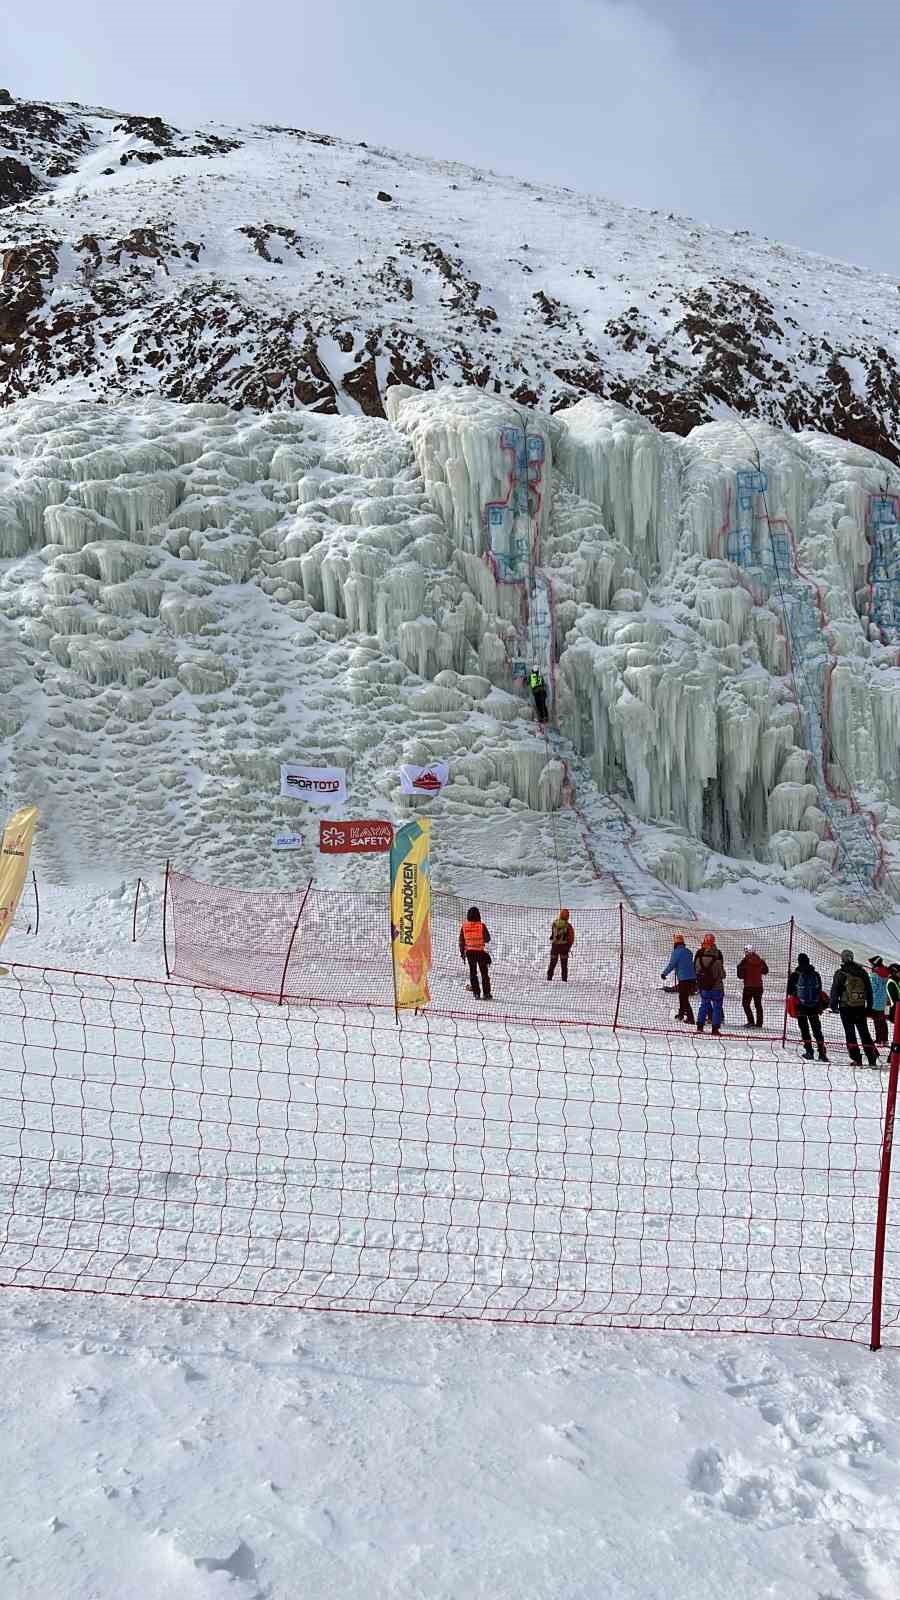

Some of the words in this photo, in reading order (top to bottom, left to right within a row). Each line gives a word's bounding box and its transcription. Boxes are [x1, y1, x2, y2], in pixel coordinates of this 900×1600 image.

[350, 825, 391, 838] KAYA
[350, 836, 391, 846] SAFETY
[402, 862, 414, 945] PALANDÖKEN
